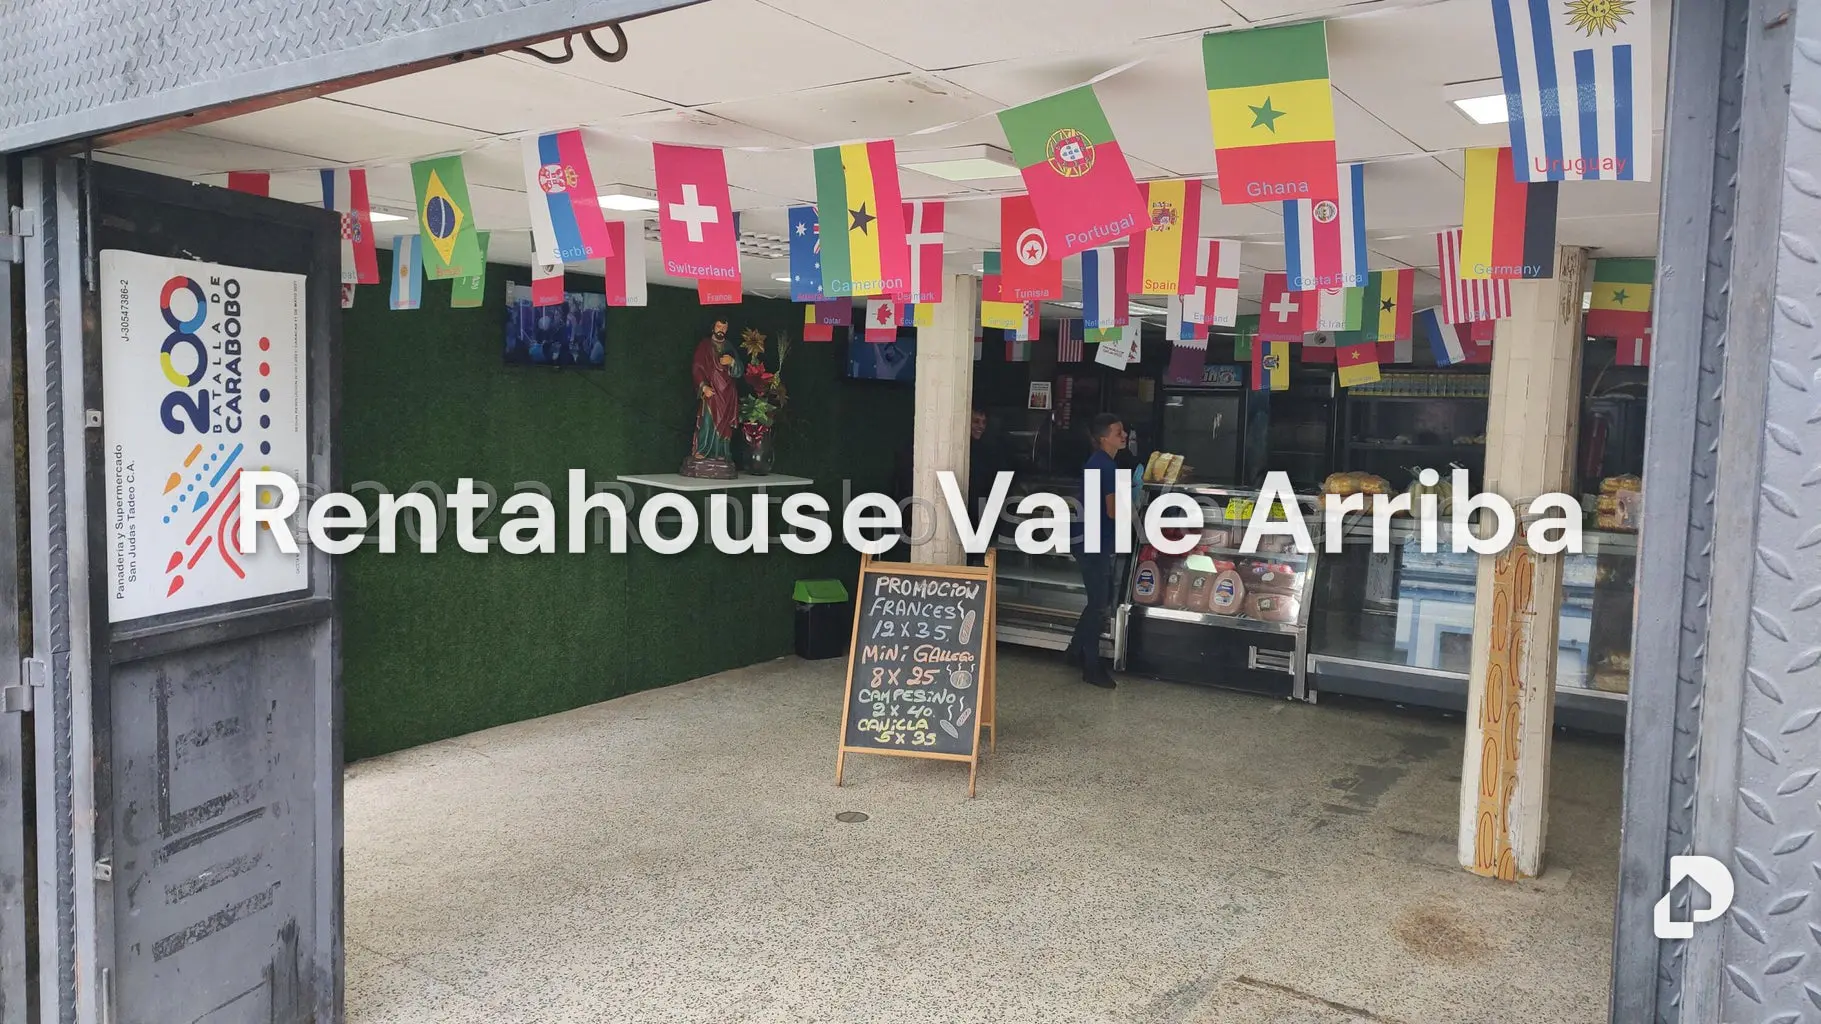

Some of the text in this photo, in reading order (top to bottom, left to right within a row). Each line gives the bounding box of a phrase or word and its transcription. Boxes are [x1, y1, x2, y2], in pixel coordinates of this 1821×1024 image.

[1535, 157, 1626, 175] Uruguay
[1247, 181, 1309, 196] Ghana
[1065, 213, 1135, 248] Portugal
[553, 245, 593, 258] Serbia
[668, 261, 735, 277] Switzerland
[1473, 263, 1541, 277] Germany
[831, 277, 903, 292] Cameroon
[1144, 279, 1177, 291] Spain
[1294, 273, 1363, 287] Costa Rica
[707, 293, 732, 302] France
[897, 292, 934, 301] Denmark
[1014, 288, 1049, 299] Tunisia
[120, 279, 129, 341] J-30547386-2
[160, 275, 210, 434] 200
[211, 276, 222, 433] BATALLA DE
[224, 278, 242, 433] CARABOBO
[114, 444, 125, 530] Supermercado
[126, 460, 137, 582] San Judas Tadeo C.A.
[868, 597, 956, 620] FRANCES
[872, 620, 895, 639] 12
[870, 667, 884, 688] 8
[872, 702, 886, 717] 2
[874, 731, 895, 743] 5
